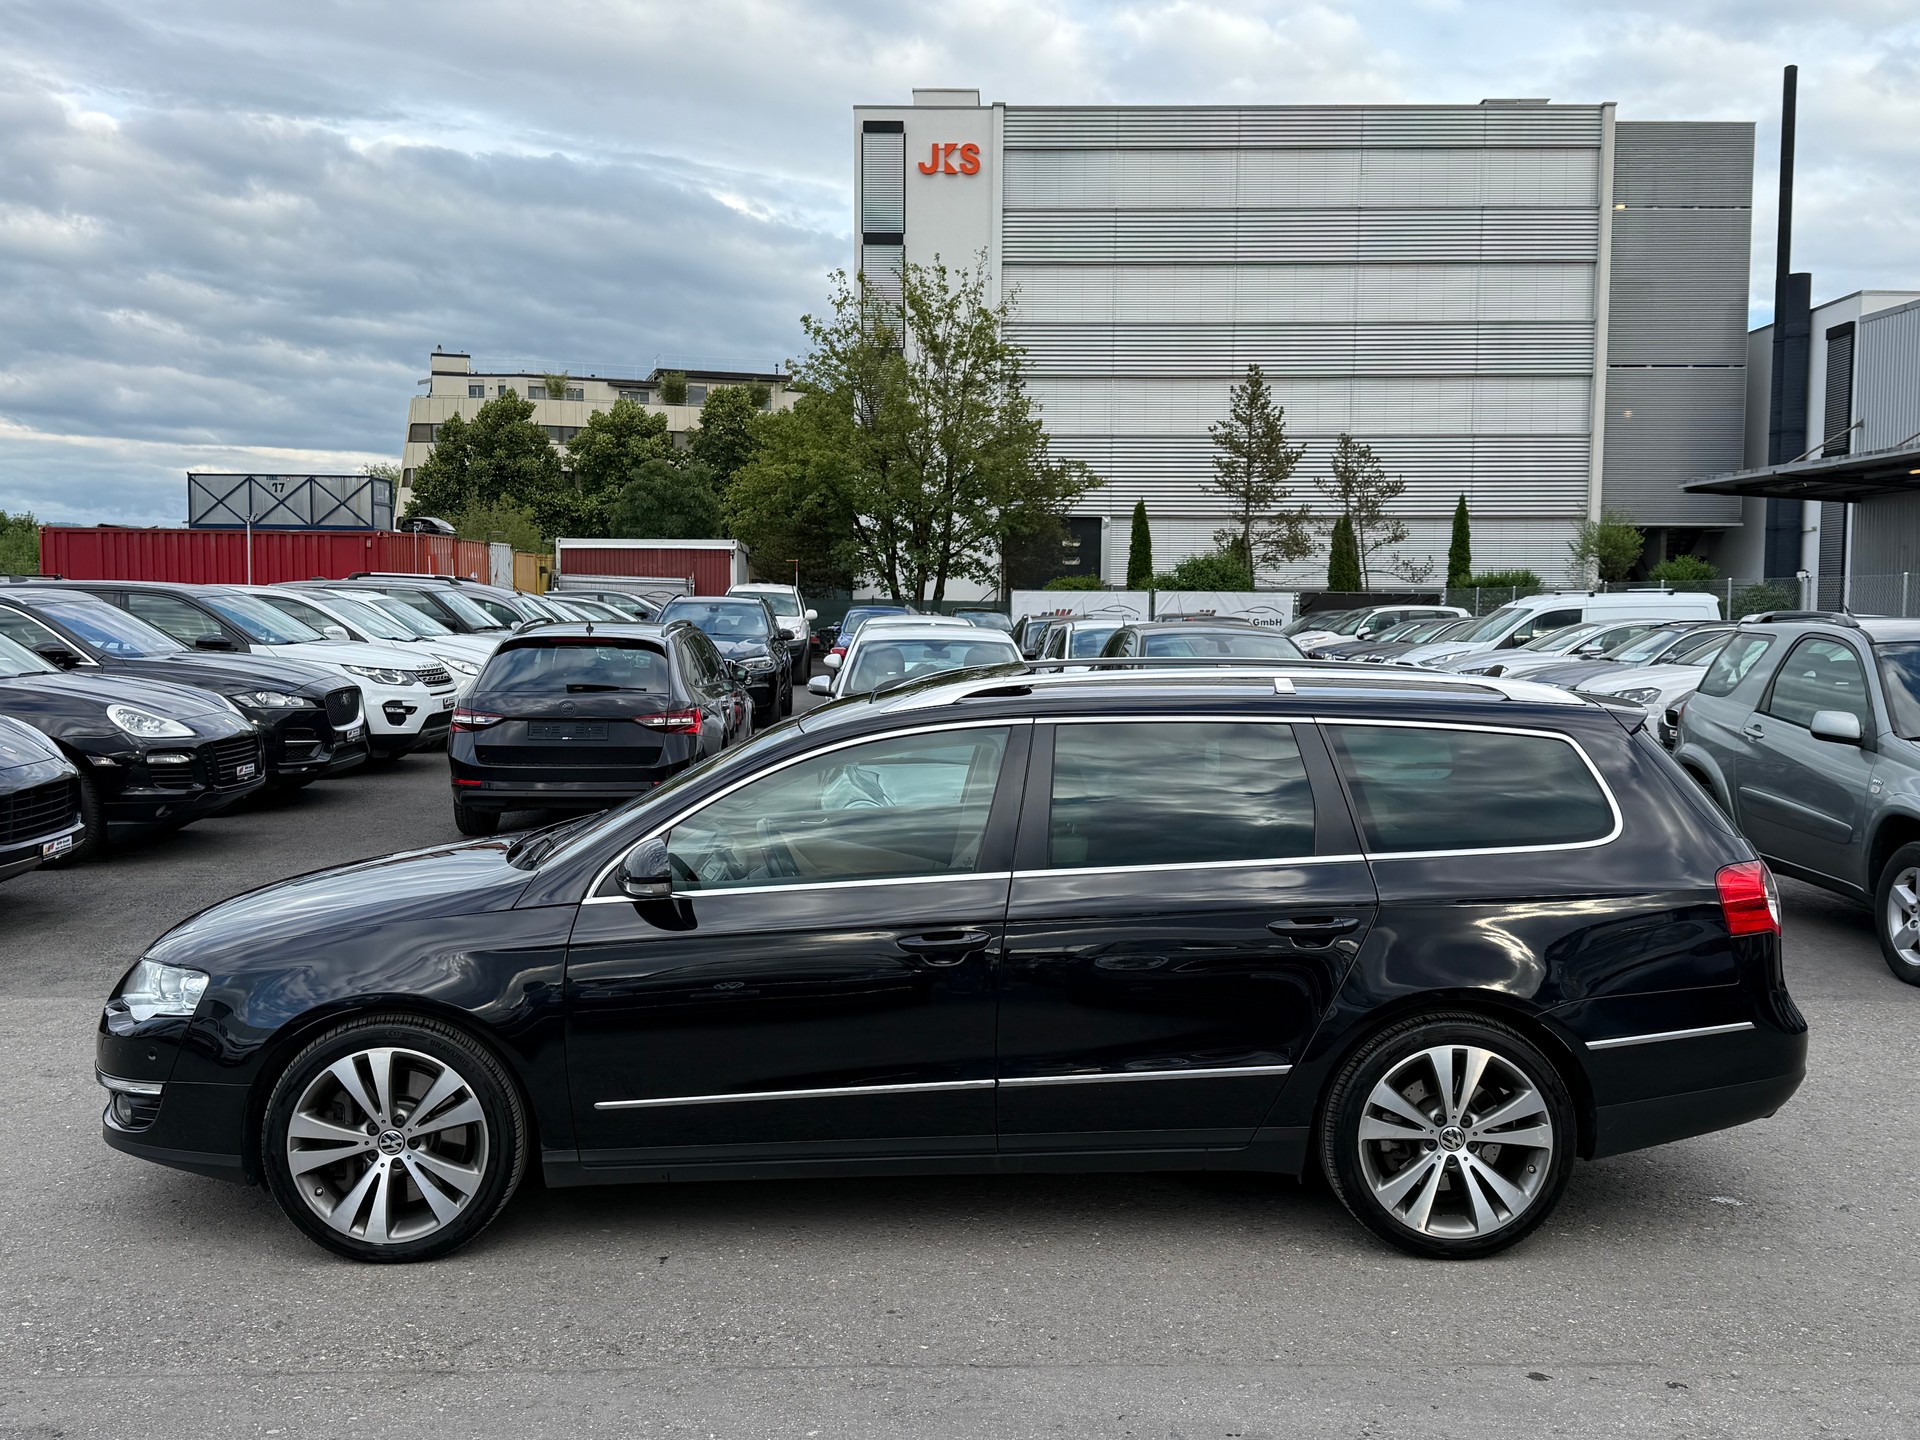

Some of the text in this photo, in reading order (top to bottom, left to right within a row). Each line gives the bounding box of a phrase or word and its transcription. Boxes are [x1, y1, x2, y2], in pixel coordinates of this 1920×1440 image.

[918, 143, 980, 175] JKS
[272, 482, 285, 493] 17
[1252, 618, 1282, 627] GmbH
